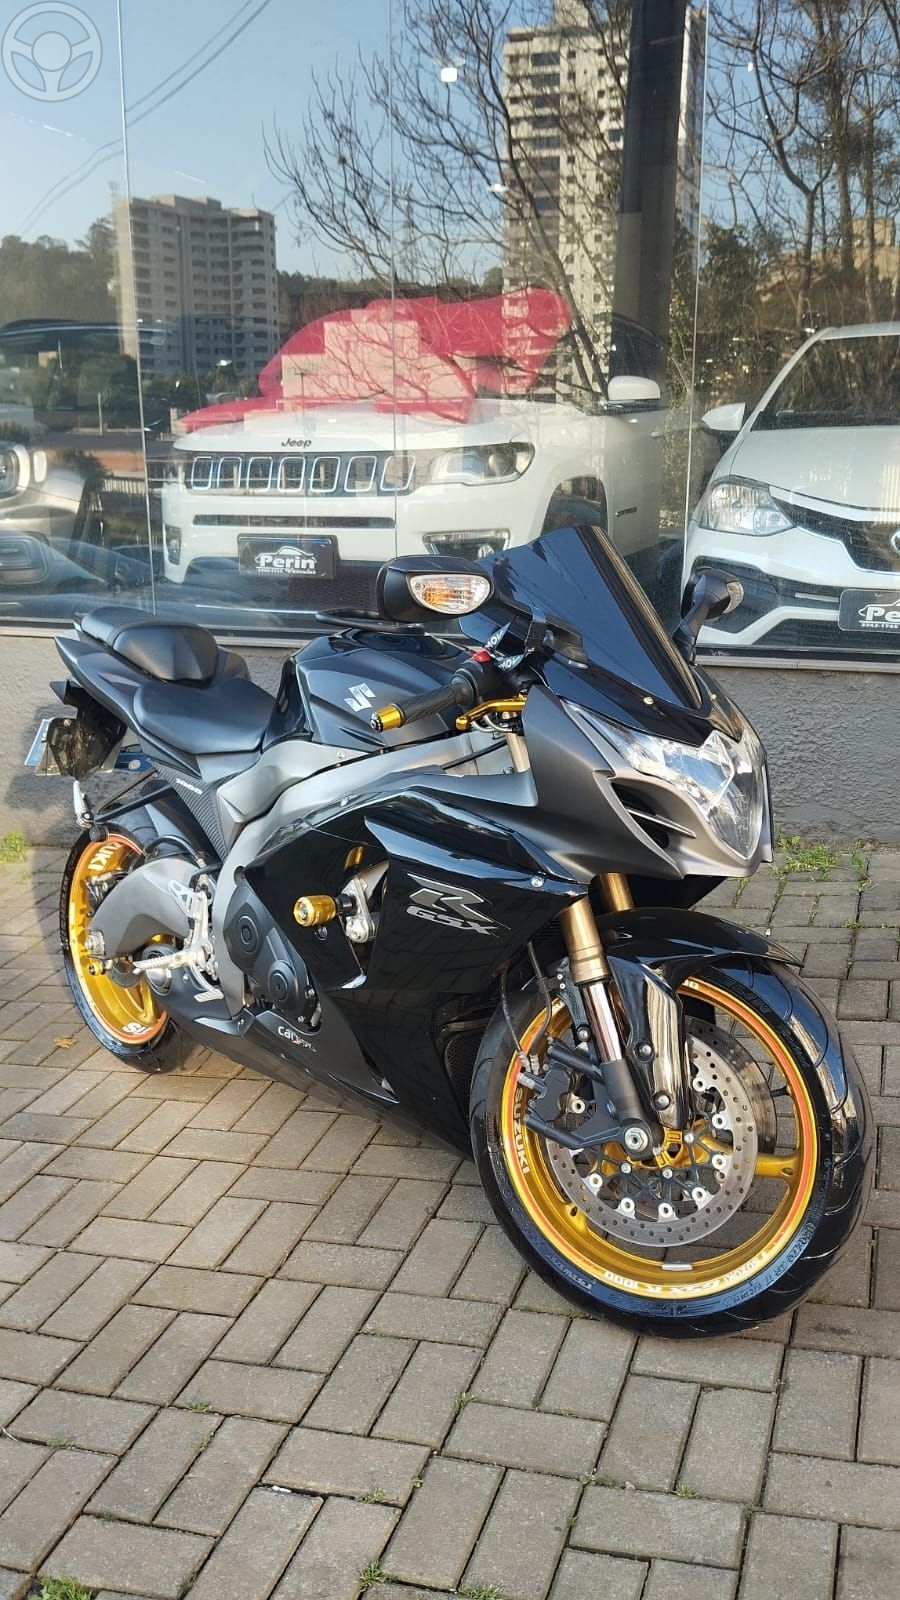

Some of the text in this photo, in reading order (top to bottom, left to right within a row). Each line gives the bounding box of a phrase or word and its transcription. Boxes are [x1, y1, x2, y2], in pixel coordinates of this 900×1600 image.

[281, 438, 312, 448] Jeep
[259, 555, 315, 569] Perin
[406, 906, 499, 935] GSX
[513, 1087, 531, 1175] SUZUKI
